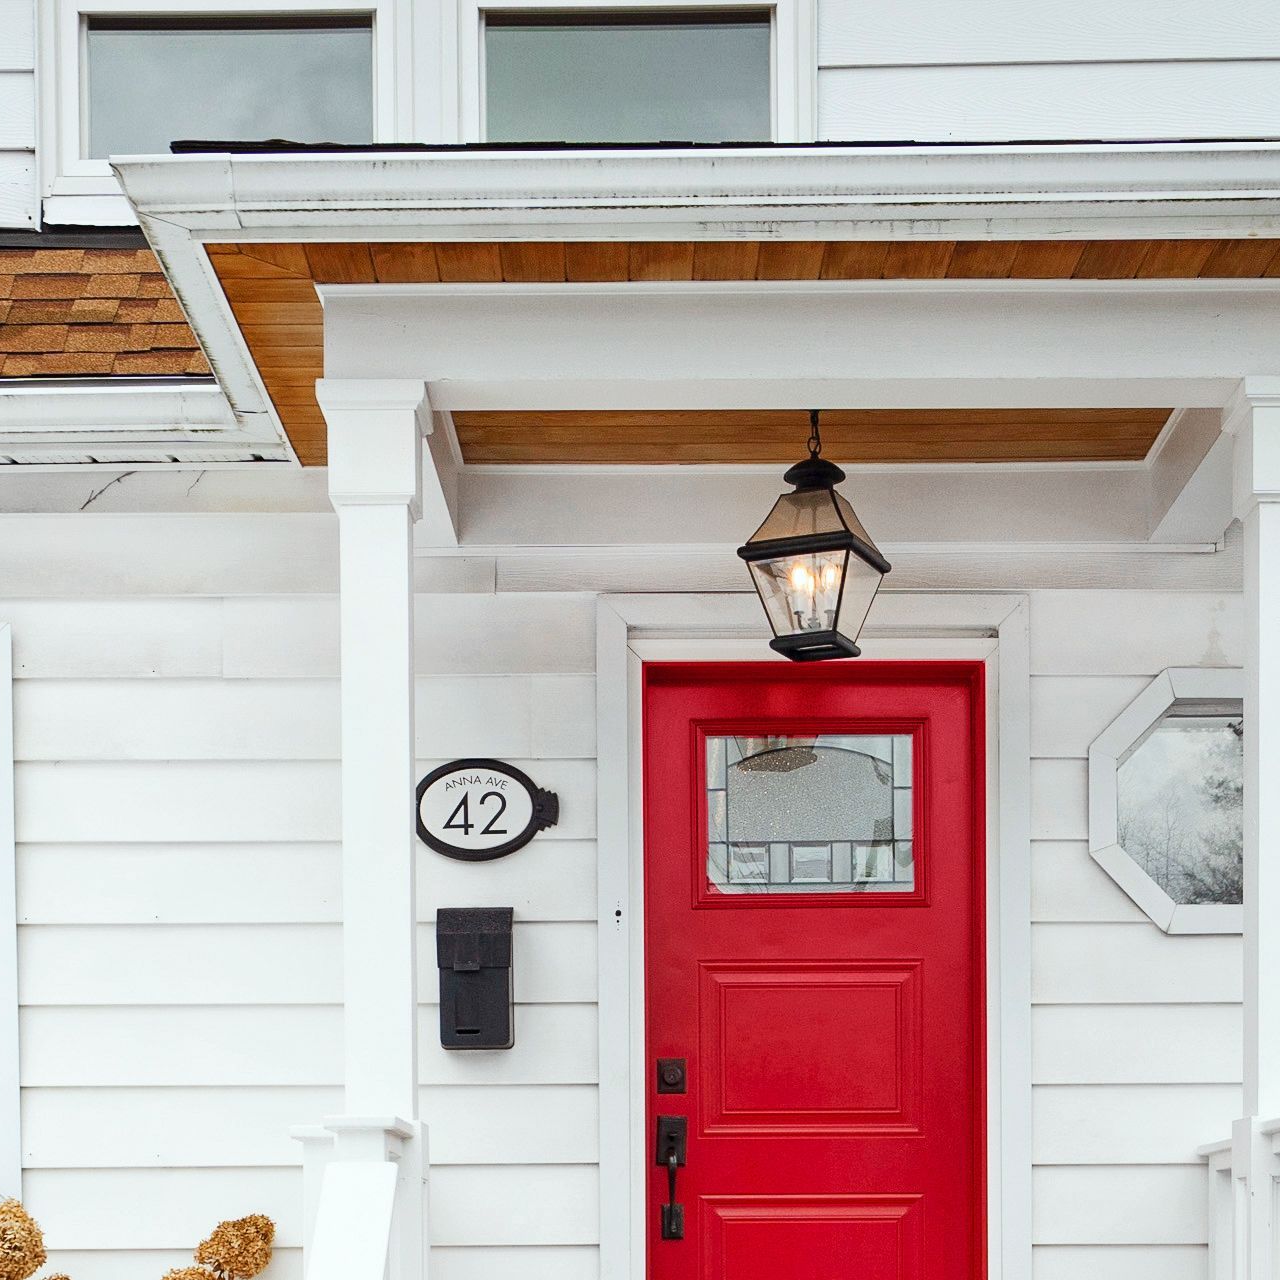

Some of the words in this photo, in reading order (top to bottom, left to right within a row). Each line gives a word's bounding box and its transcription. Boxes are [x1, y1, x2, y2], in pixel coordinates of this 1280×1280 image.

[445, 775, 482, 791] ANNA
[485, 776, 509, 791] AVE
[442, 791, 508, 835] 42
